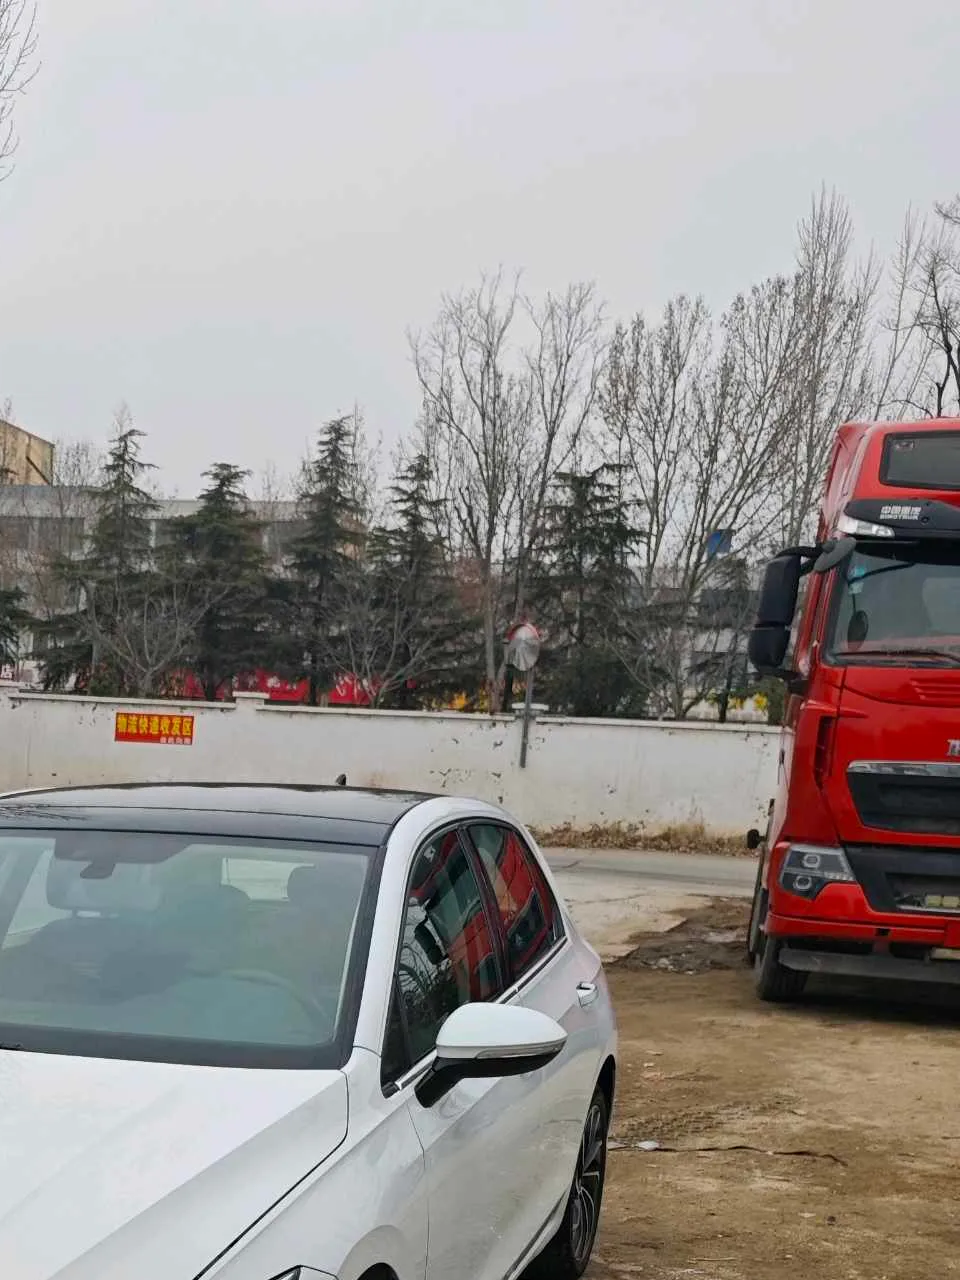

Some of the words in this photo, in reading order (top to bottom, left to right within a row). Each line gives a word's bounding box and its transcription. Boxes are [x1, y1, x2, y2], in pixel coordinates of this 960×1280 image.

[117, 714, 193, 736] 物流快递收发区
